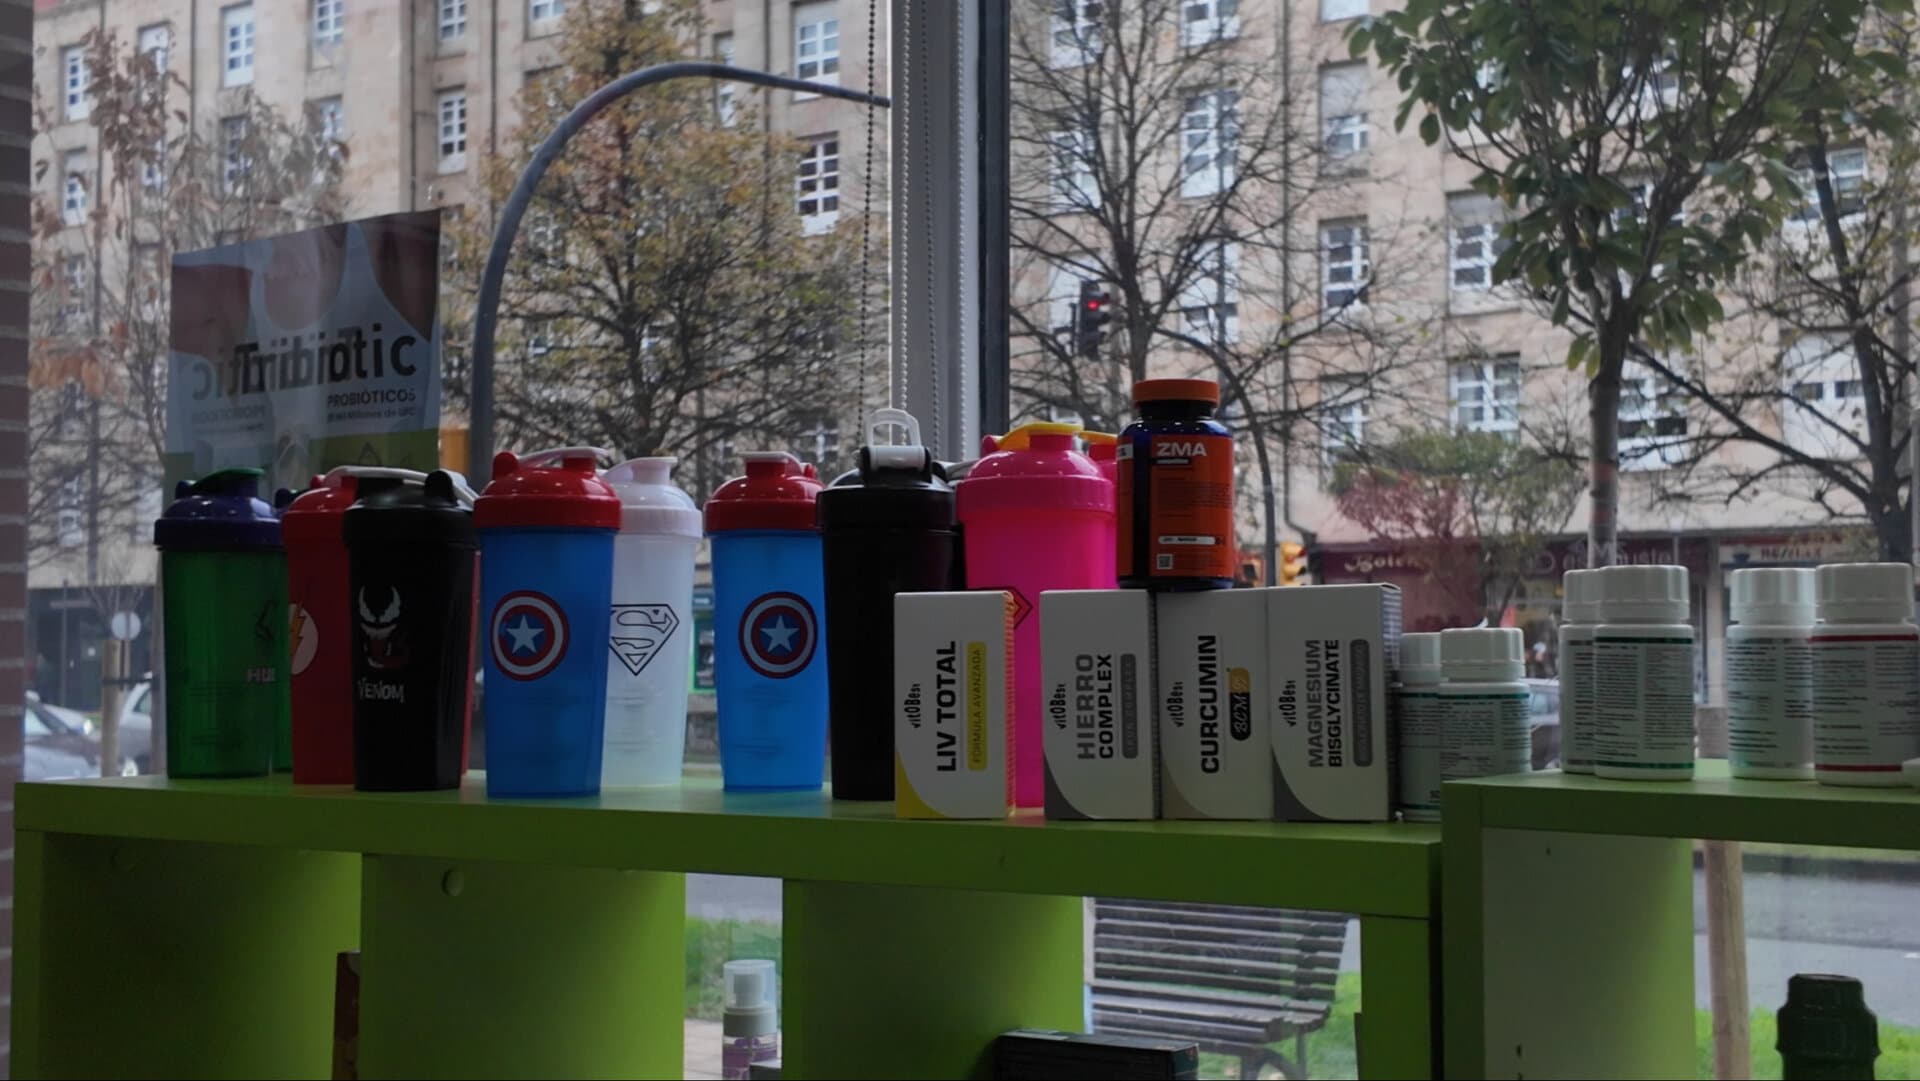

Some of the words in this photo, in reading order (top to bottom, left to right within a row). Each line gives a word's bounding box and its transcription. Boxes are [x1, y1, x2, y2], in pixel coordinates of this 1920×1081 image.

[1156, 441, 1208, 457] ZMA
[358, 678, 405, 704] VENOM
[936, 641, 956, 722] TOTAL
[1075, 654, 1096, 760] HIERRO
[1097, 654, 1115, 760] COMPLEX
[1198, 635, 1219, 774] CURCUMIN
[1306, 639, 1323, 768] MAGNESIUM
[1325, 639, 1343, 768] BISGLYCINATE
[937, 732, 957, 772] LIV
